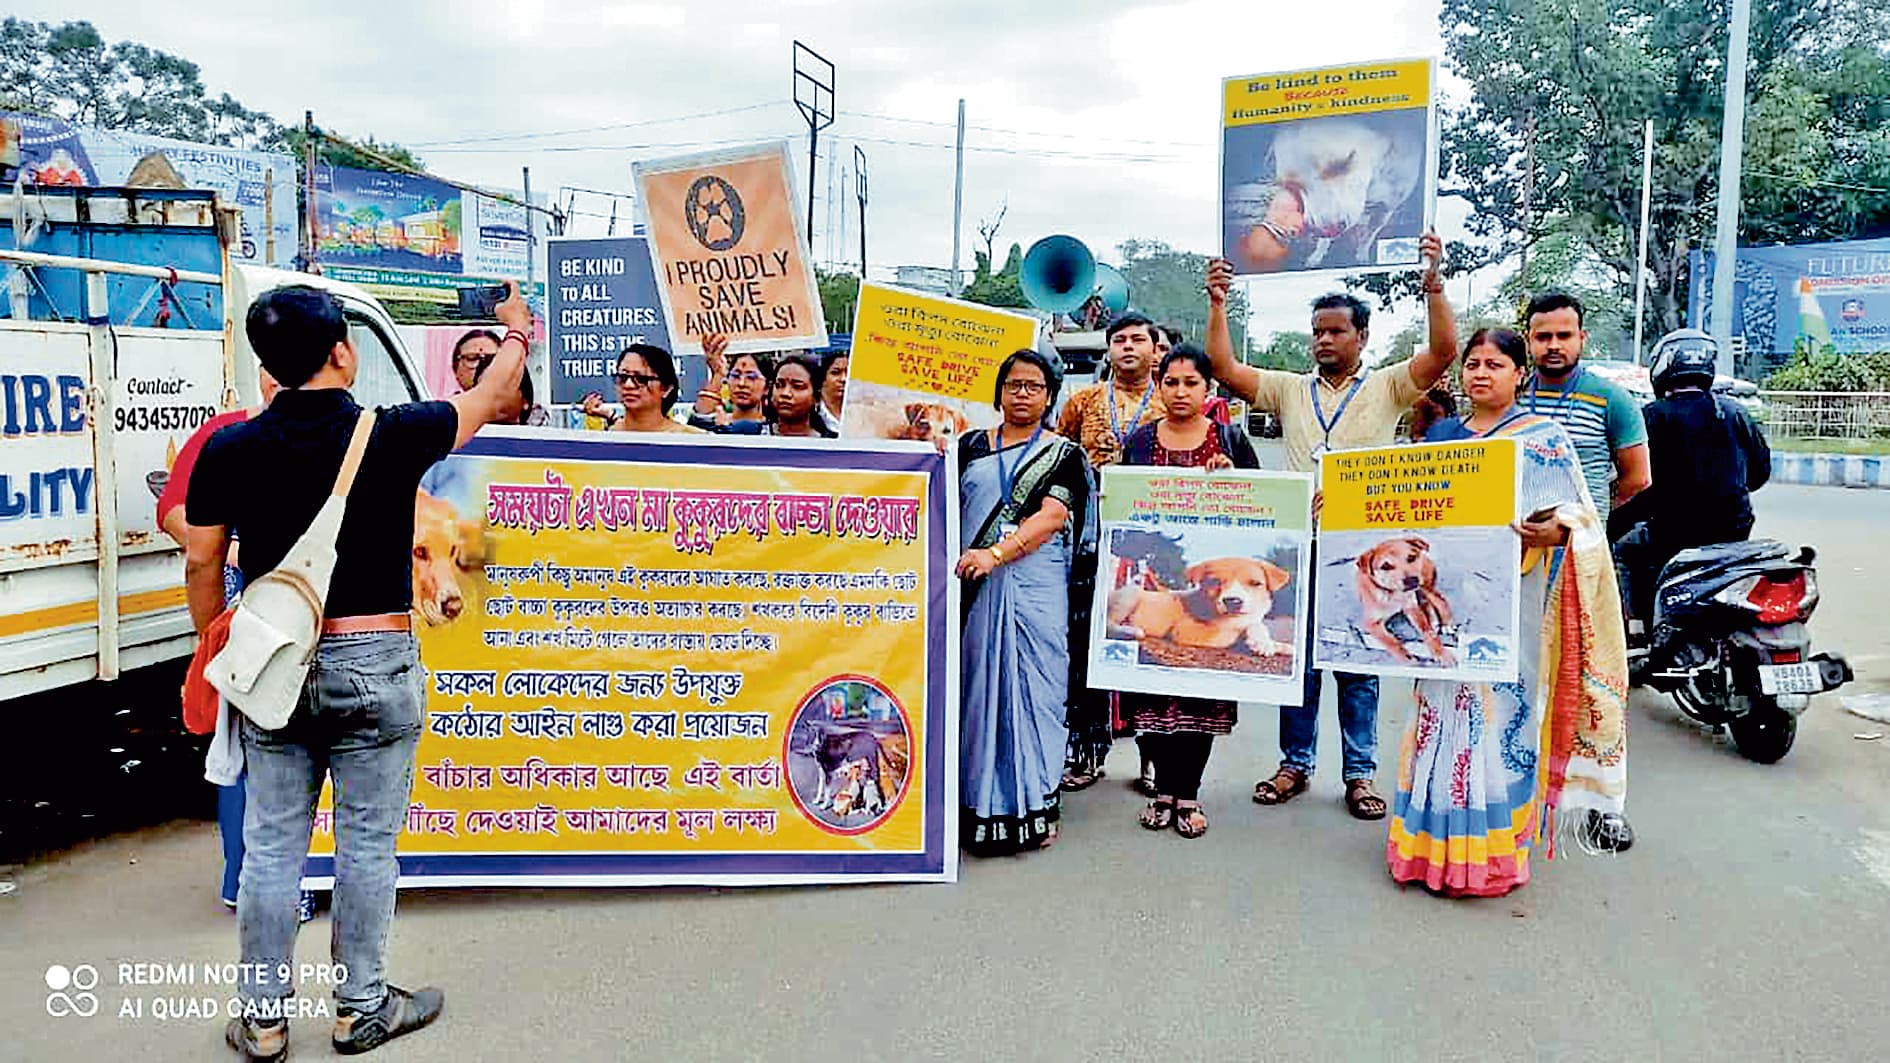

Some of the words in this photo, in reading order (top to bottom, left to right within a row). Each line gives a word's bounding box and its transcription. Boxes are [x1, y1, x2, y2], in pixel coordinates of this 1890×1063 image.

[1276, 75, 1318, 90] kind
[1325, 73, 1343, 84] to
[1349, 69, 1397, 81] them
[1232, 102, 1312, 119] Humanity
[1330, 94, 1410, 108] kindness
[561, 258, 583, 276] BE
[585, 257, 625, 276] KIND
[665, 263, 673, 286] I
[679, 251, 790, 285] PROUDLY
[581, 284, 612, 302] ALL
[699, 282, 765, 310] SAVE
[561, 308, 659, 327] CREATURES.
[685, 305, 798, 336] ANIMALS!
[561, 334, 599, 352] THIS
[601, 336, 616, 351] IS
[561, 359, 603, 377] TRUE
[897, 352, 934, 366] SAFE
[941, 360, 981, 377] DRIVE
[901, 364, 940, 379] SAVE
[947, 372, 974, 386] LIFE
[2, 375, 86, 434] IRE
[1336, 457, 1360, 468] THEY
[1399, 451, 1432, 464] KNOW
[1437, 447, 1485, 461] DANGER
[1340, 471, 1363, 482] THEY
[1403, 465, 1436, 477] KNOW
[1441, 463, 1480, 475] DEATH
[1366, 483, 1386, 496] BUT
[1391, 482, 1412, 493] YOU
[1415, 480, 1451, 492] KNOW
[1365, 499, 1400, 512] SAFE
[1410, 496, 1455, 510] DRIVE
[576, 487, 638, 530] এখন
[641, 490, 670, 530] মা
[672, 491, 770, 554] কুকুরদের
[774, 495, 832, 537] বাচ্চা
[836, 496, 920, 544] দেওয়ার
[1365, 511, 1406, 523] SAVE
[1414, 510, 1444, 522] LIFE
[435, 670, 496, 696] সকল
[504, 670, 609, 698] লোকেদের
[616, 670, 665, 698] জন্য
[672, 666, 743, 705] উপযুক্ত
[430, 705, 504, 738] কঠোর
[510, 708, 576, 740] আইন
[631, 712, 677, 739] করা
[683, 713, 769, 740] প্রয়োজন
[423, 758, 492, 790] বাঁচার
[500, 757, 598, 790] অধিকার
[606, 764, 670, 790] আছে
[684, 761, 723, 790] এই
[729, 757, 782, 790] বার্তা
[466, 801, 557, 835] দেওয়াই
[565, 808, 670, 833] আমাদের
[676, 809, 716, 839] মূল
[722, 809, 778, 835] লক্ষ্য
